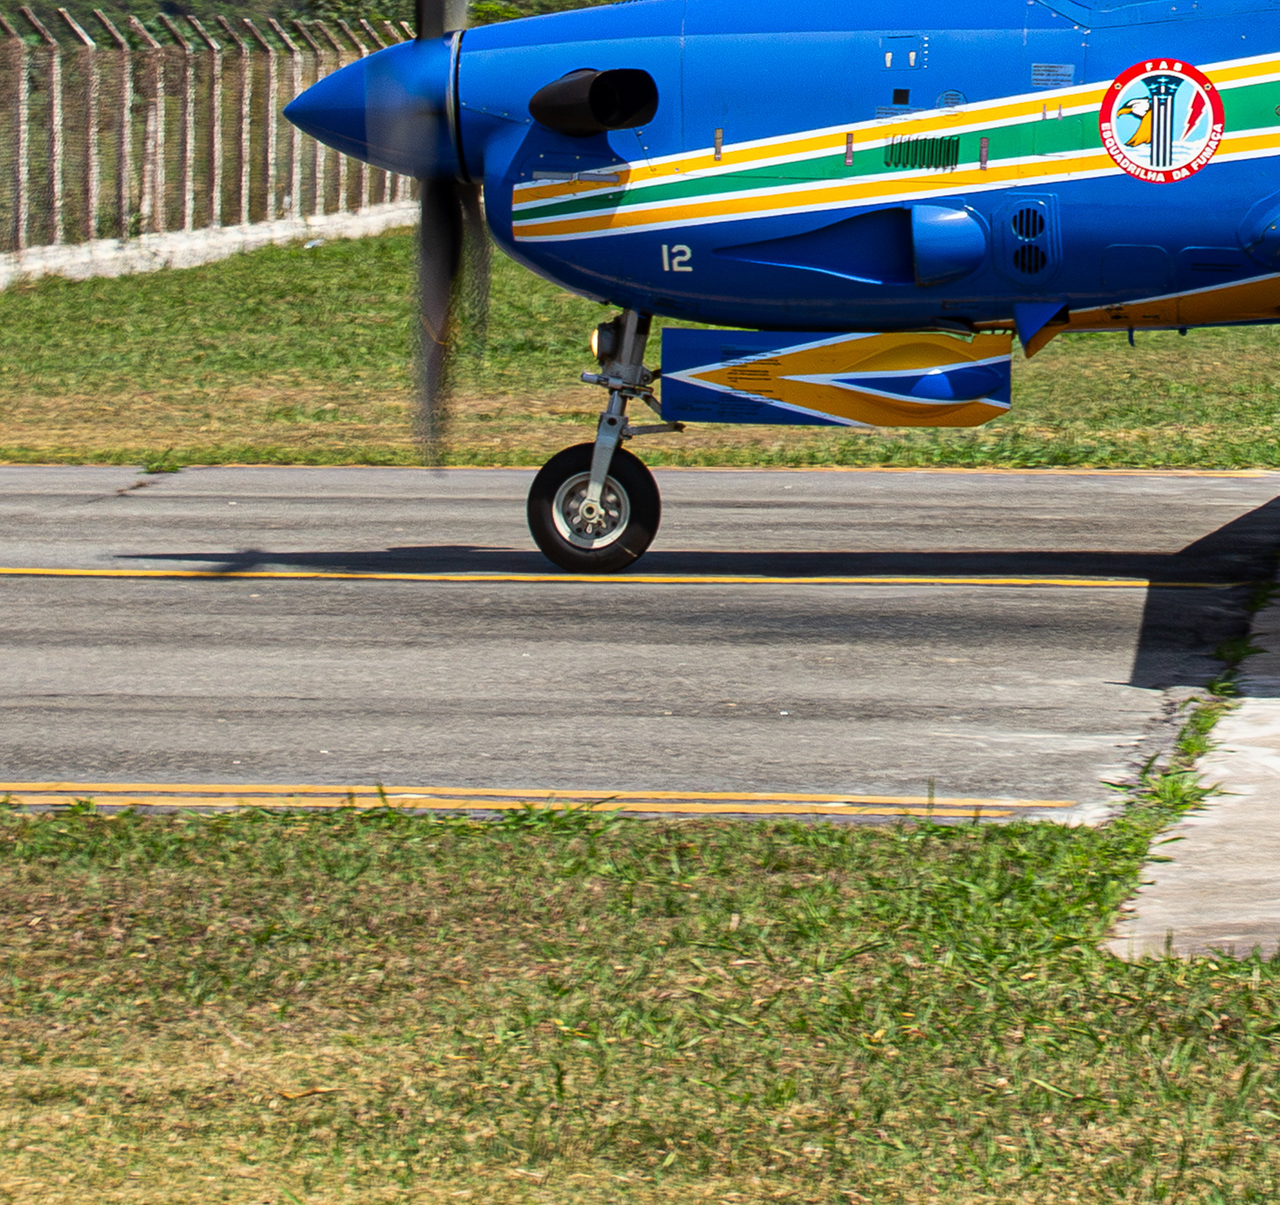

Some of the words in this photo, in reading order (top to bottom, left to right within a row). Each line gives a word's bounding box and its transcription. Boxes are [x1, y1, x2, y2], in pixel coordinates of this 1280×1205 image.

[1145, 60, 1183, 72] FAB
[1101, 122, 1165, 182] ESQUADRILHA
[1172, 168, 1190, 180] DA
[661, 244, 693, 272] 12
